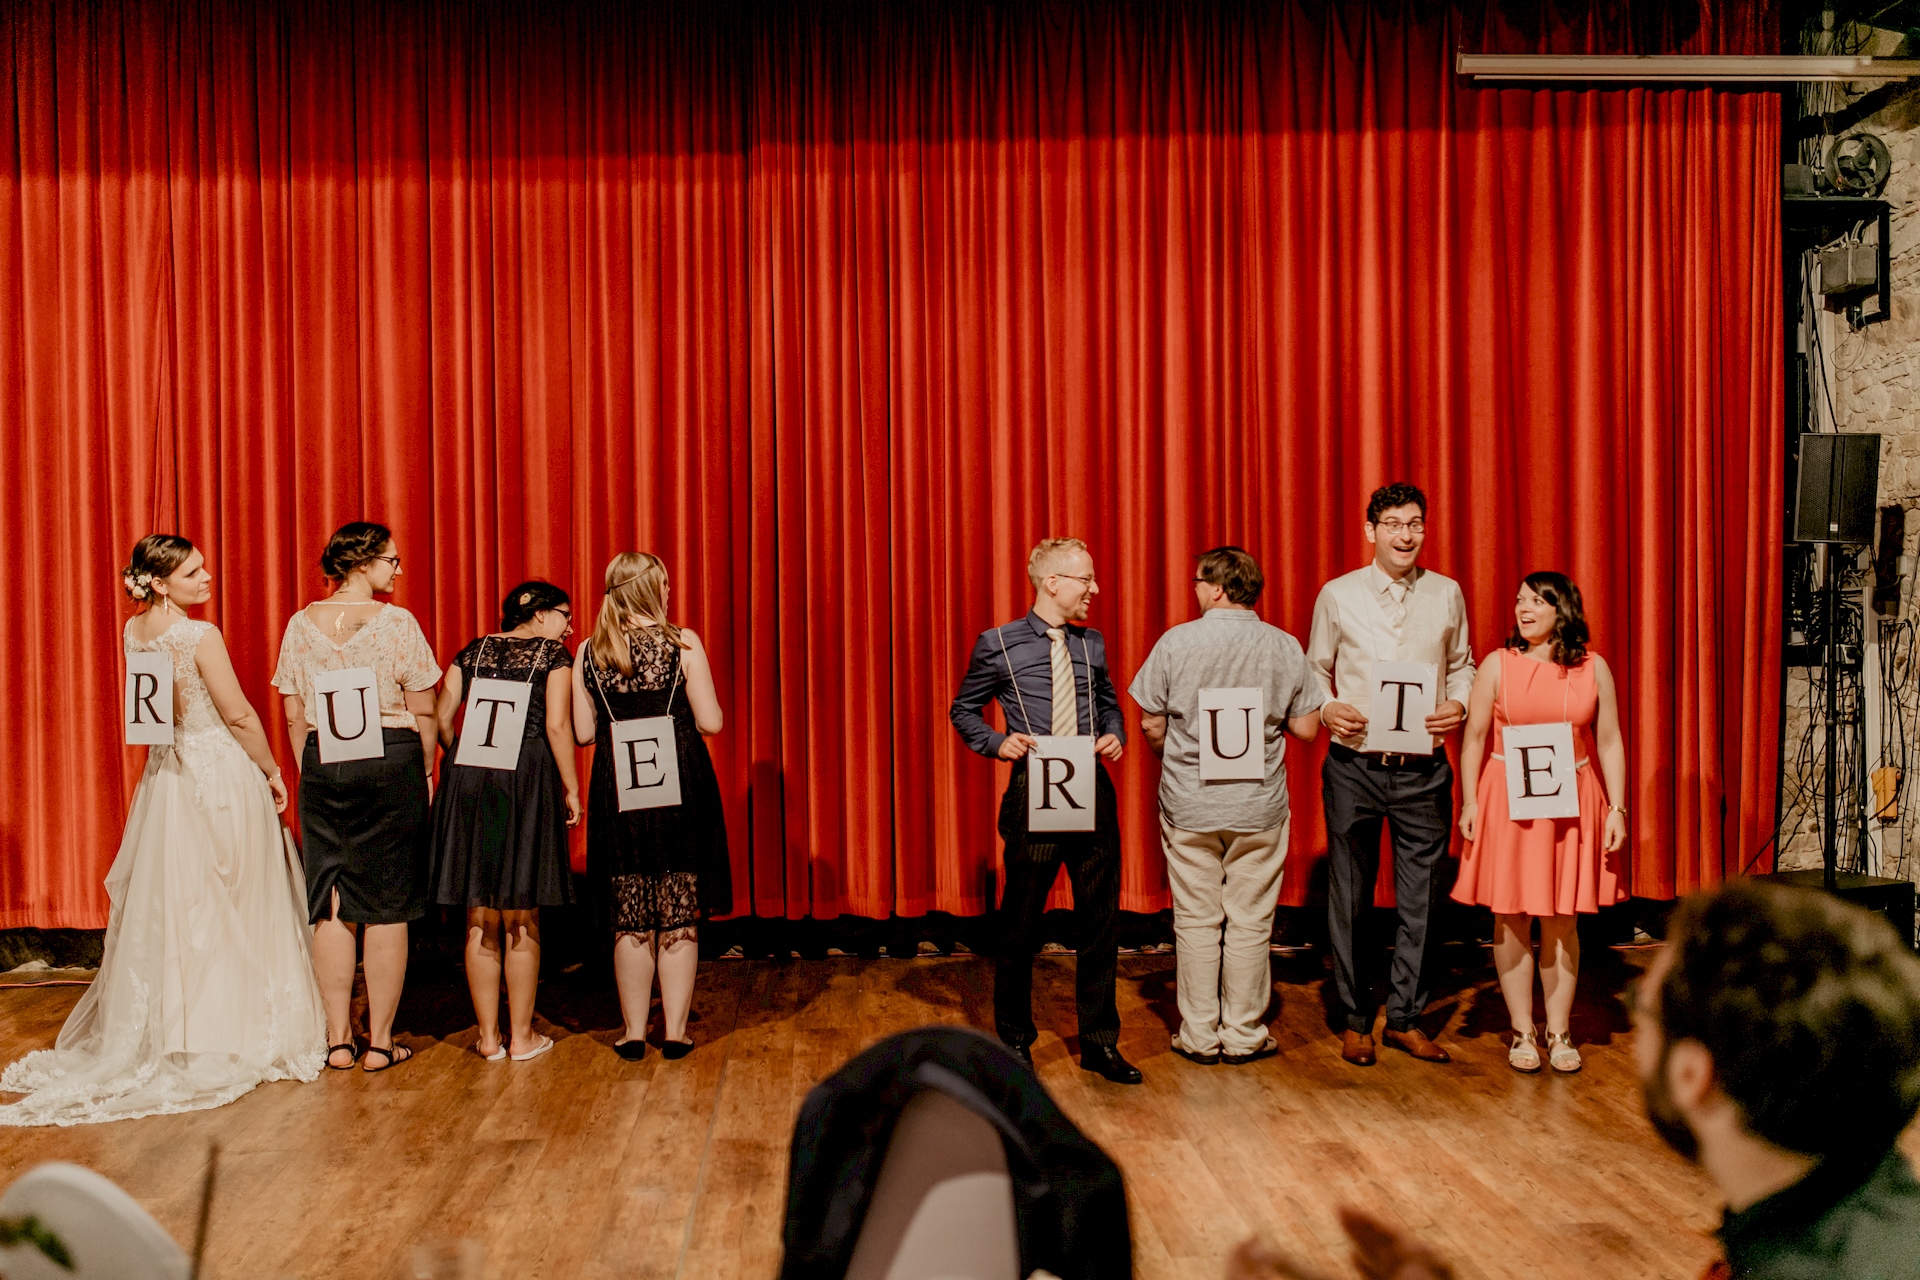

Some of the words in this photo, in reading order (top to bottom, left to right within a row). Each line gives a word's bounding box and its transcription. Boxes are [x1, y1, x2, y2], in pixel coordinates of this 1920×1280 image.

[130, 673, 166, 724] R
[318, 686, 370, 741] U
[475, 698, 515, 748] T
[1381, 681, 1423, 732] T
[1203, 708, 1256, 759] U
[621, 738, 665, 790] E
[1035, 758, 1086, 810] R
[1514, 745, 1562, 798] E
